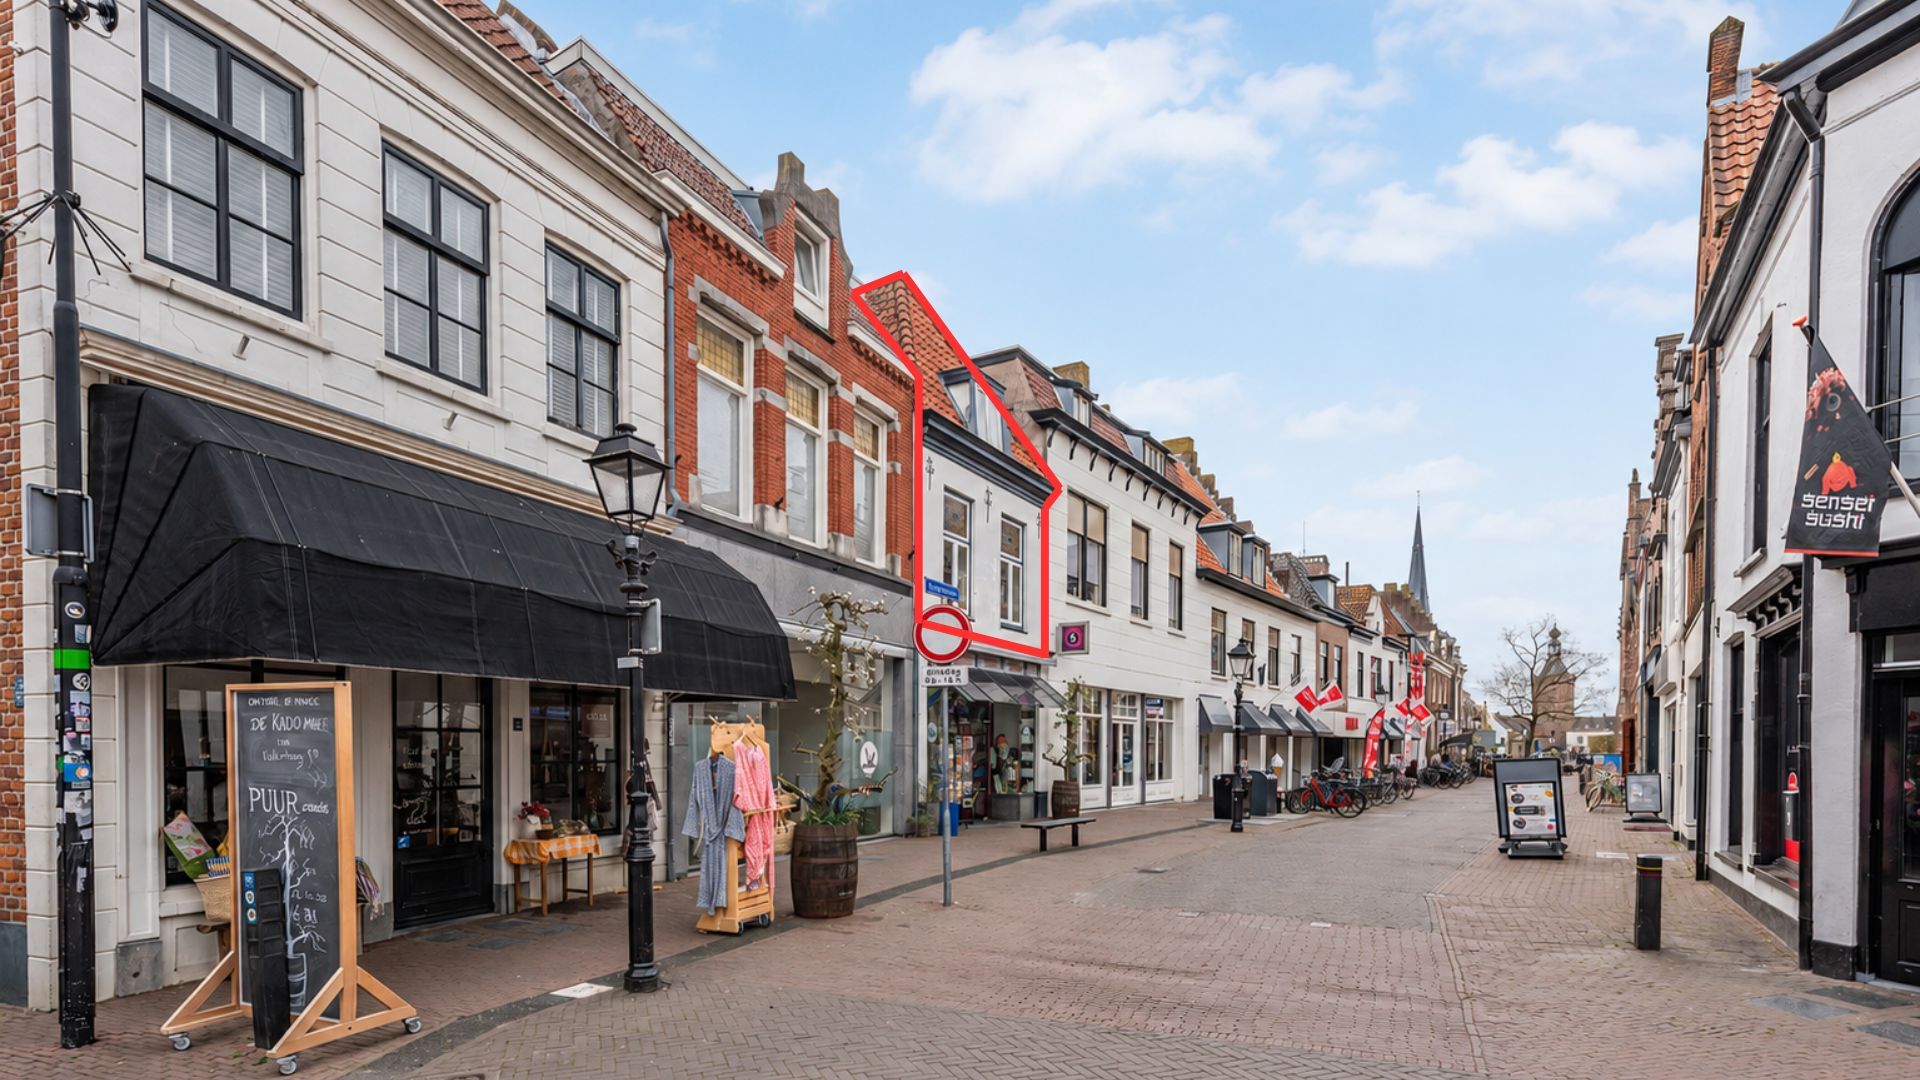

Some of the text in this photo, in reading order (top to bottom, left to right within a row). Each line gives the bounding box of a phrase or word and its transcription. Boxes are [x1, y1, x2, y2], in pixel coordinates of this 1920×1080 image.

[1801, 492, 1876, 513] sensei
[1804, 510, 1865, 530] sushi
[1070, 632, 1077, 643] 6
[272, 713, 301, 731] KADO
[248, 787, 300, 815] PUUR
